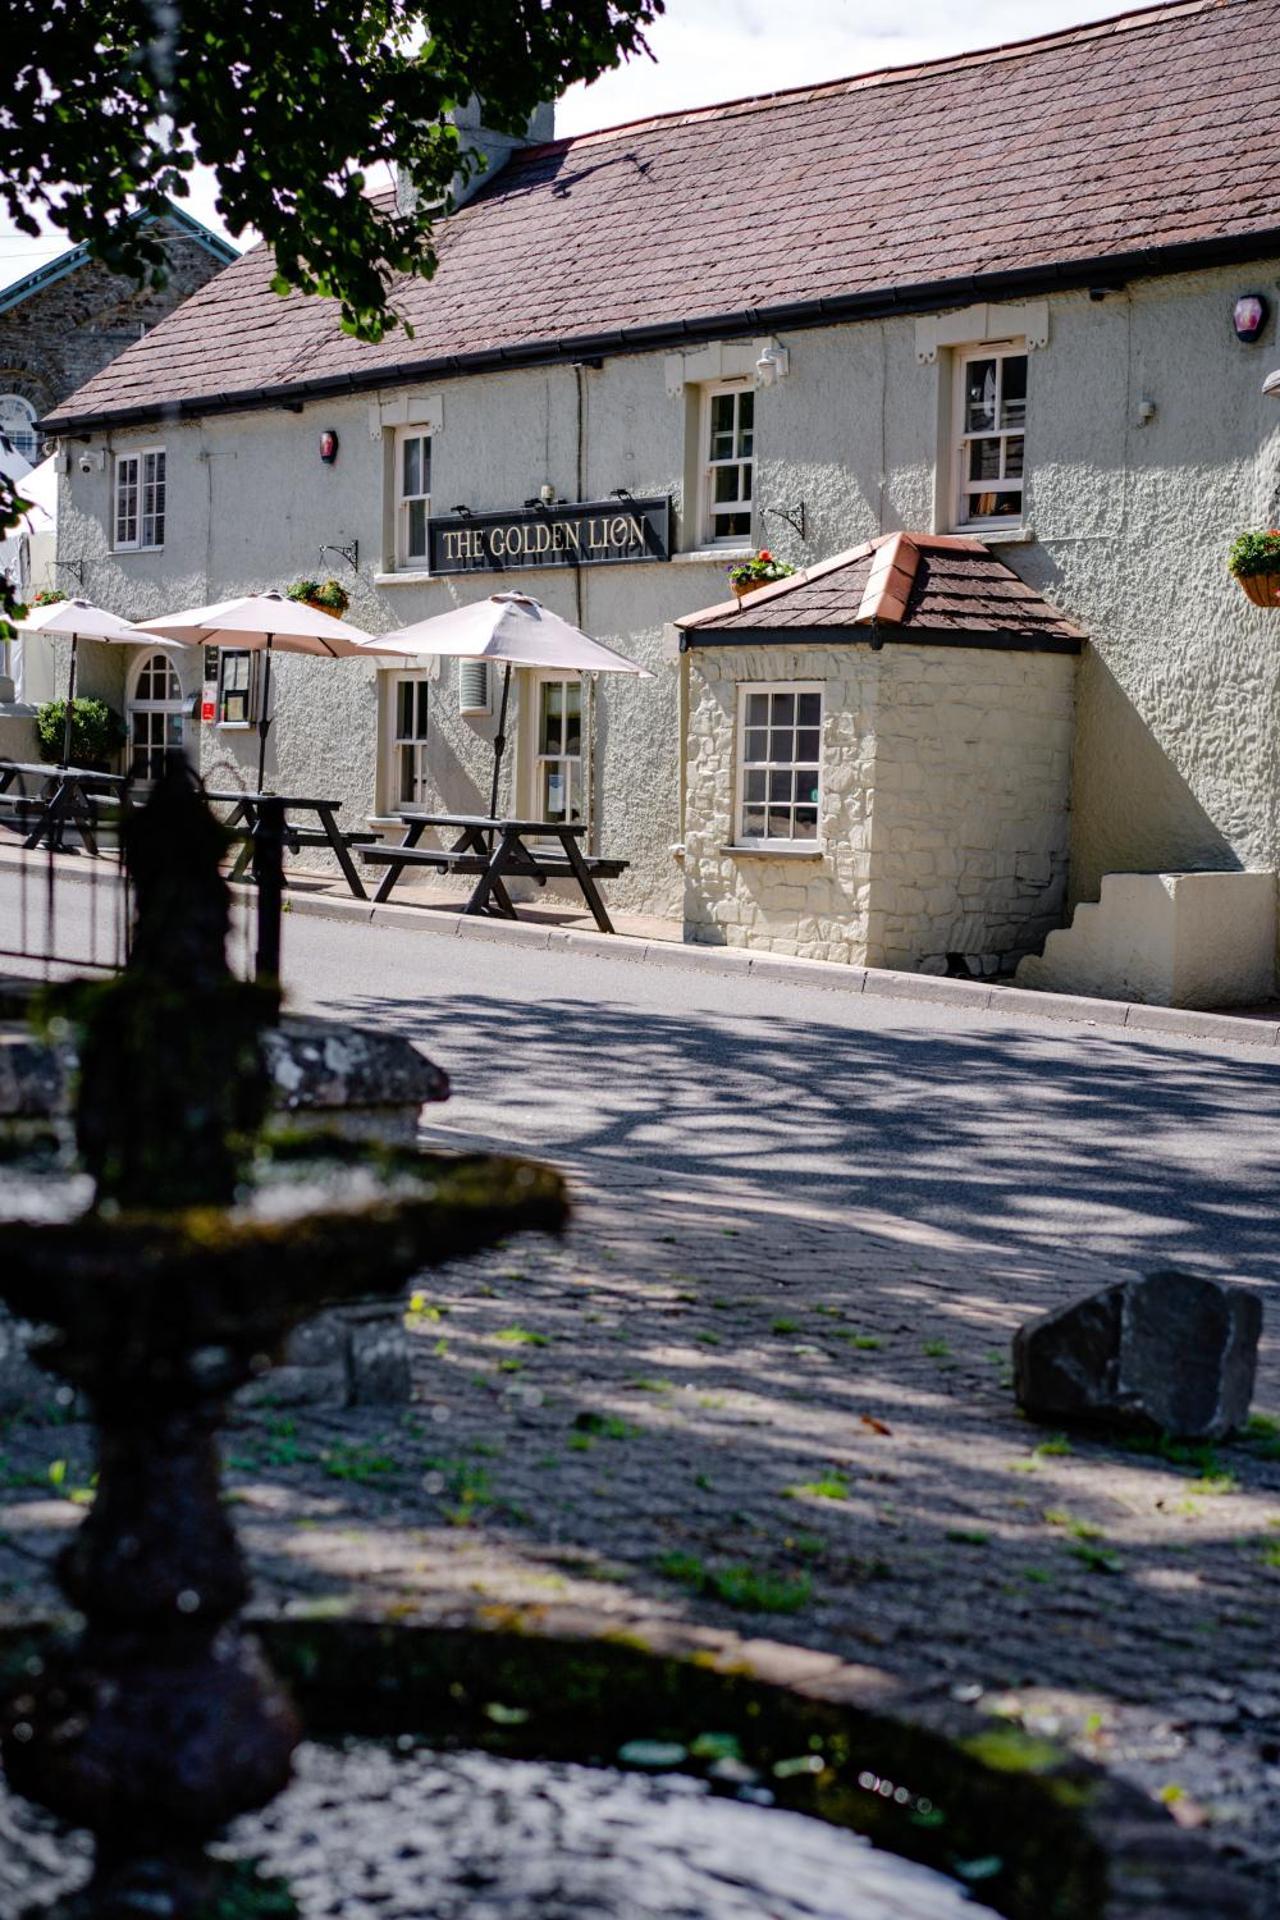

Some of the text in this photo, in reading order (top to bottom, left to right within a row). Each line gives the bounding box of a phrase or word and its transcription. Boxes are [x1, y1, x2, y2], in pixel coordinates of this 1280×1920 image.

[443, 515, 646, 559] THE GOLDEN LION
